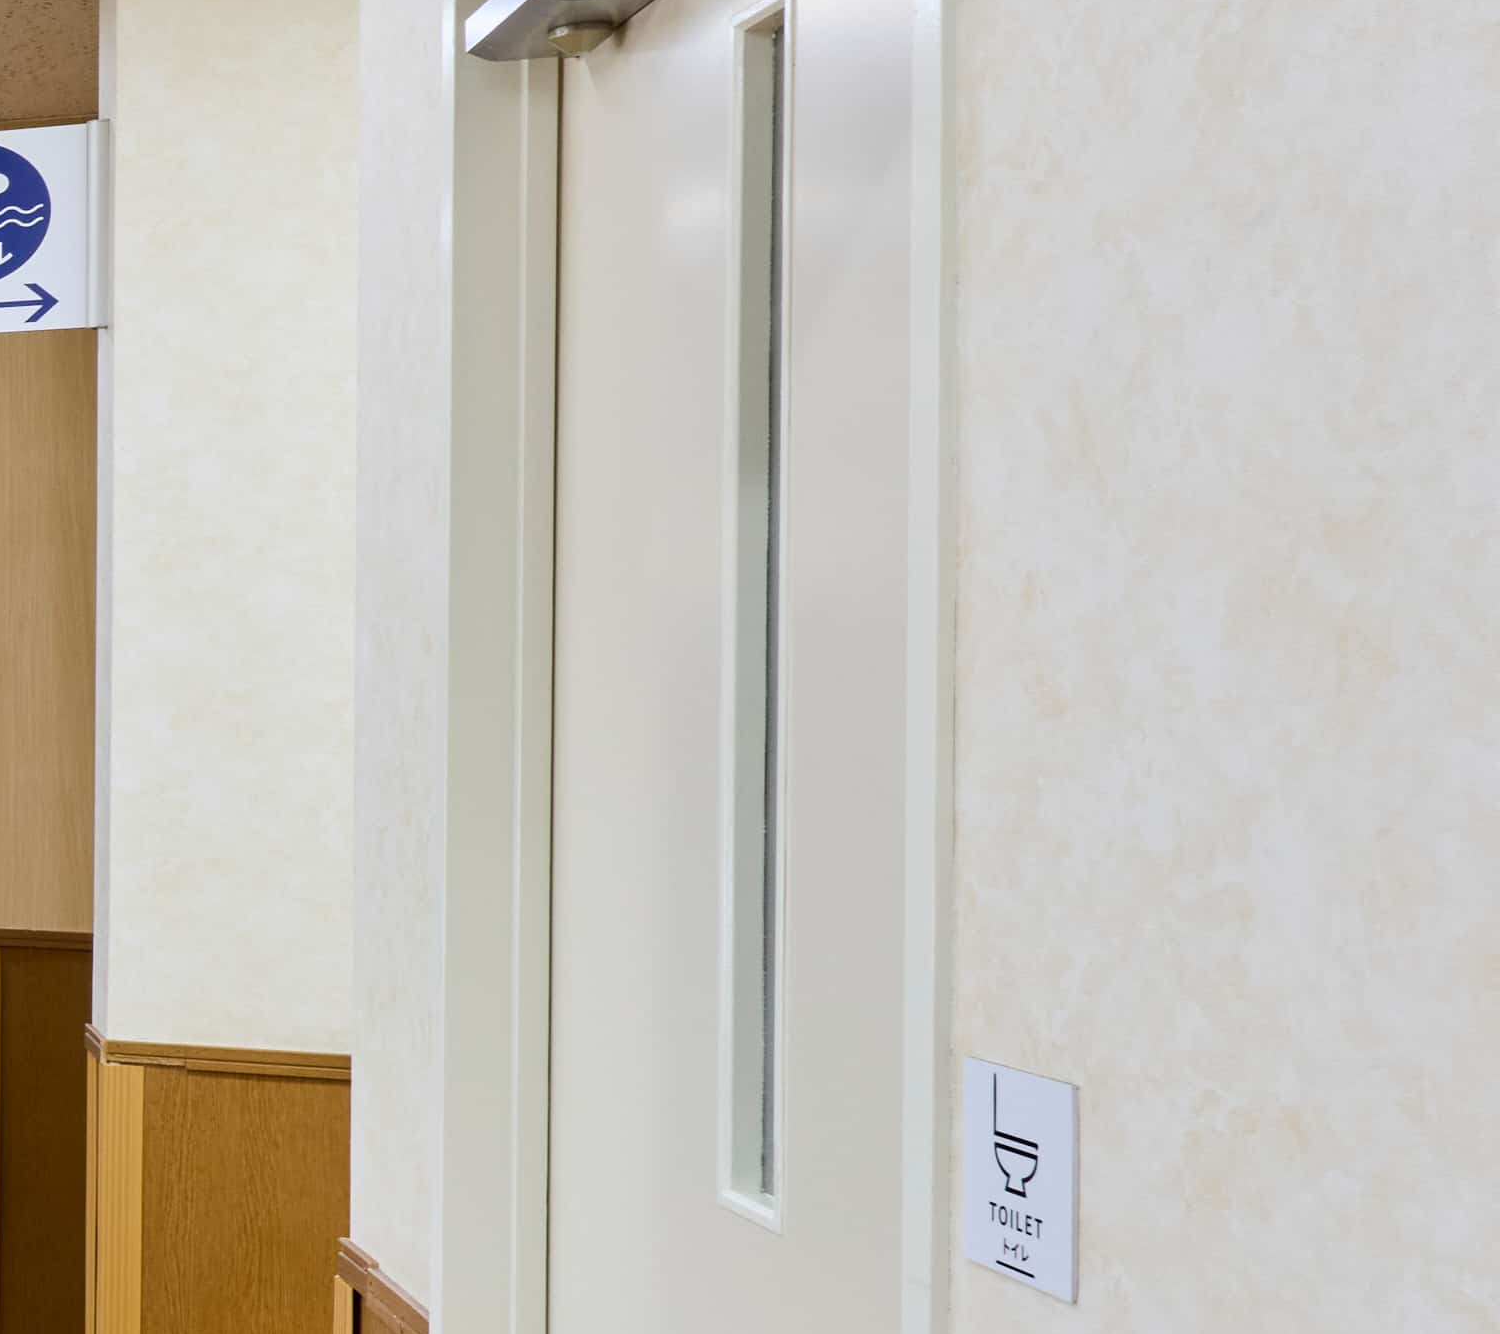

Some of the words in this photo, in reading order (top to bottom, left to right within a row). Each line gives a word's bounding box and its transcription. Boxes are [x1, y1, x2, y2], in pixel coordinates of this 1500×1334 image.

[988, 1201, 1043, 1239] TOILET
[1003, 1237, 1029, 1262] トイレ
